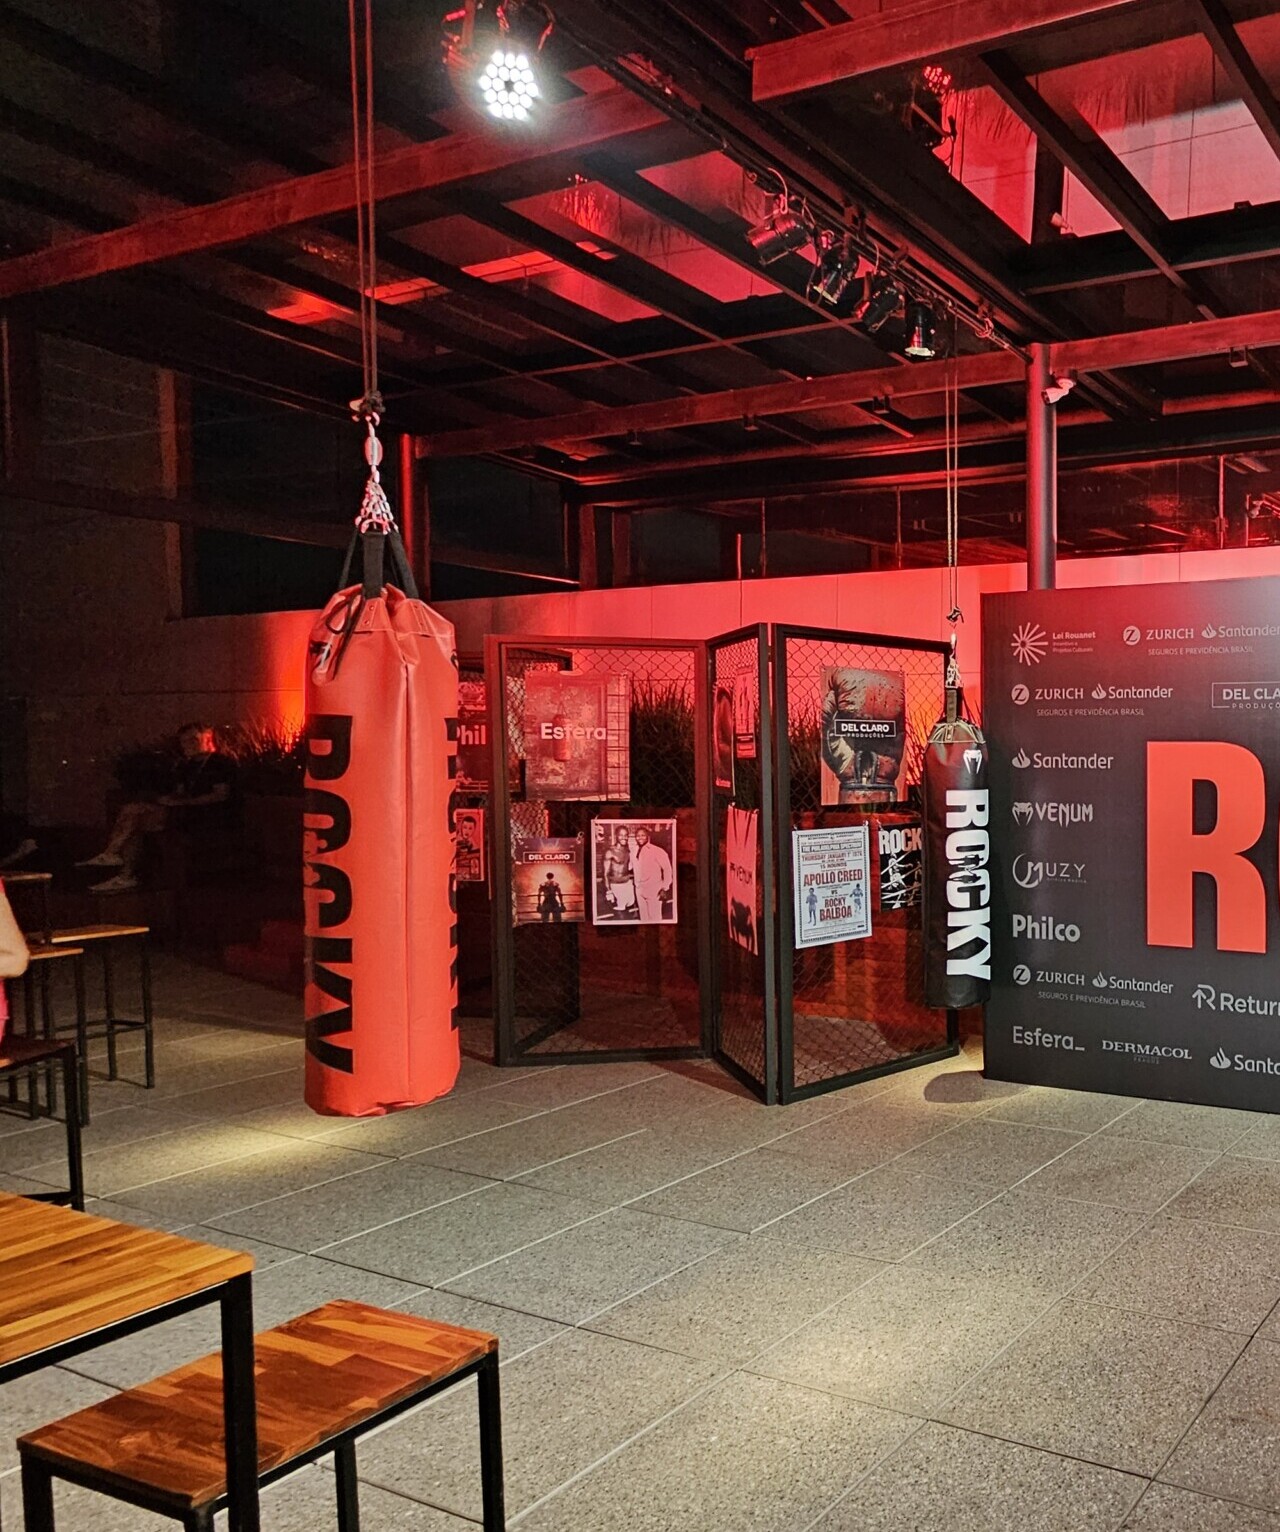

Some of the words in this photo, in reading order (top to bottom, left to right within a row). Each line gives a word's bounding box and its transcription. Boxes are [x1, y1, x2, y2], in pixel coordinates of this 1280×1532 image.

[1146, 628, 1194, 641] ZURICH
[1035, 688, 1084, 700] ZURICH
[1108, 685, 1173, 699] Santander
[1222, 688, 1250, 700] DEL
[456, 724, 487, 745] hil
[840, 723, 859, 732] DEL
[860, 724, 890, 732] CLARO
[1033, 753, 1114, 769] Santander
[1035, 802, 1093, 828] VENUM
[878, 827, 922, 855] ROCK
[803, 871, 835, 887] APOLLO
[837, 869, 863, 883] CREED
[946, 788, 991, 981] ROCKY
[825, 897, 846, 908] ROCKY
[820, 905, 852, 921] BALBOA
[1012, 914, 1081, 942] Philco
[1036, 970, 1085, 986] ZURICH
[1109, 976, 1174, 994] Santander
[1102, 1040, 1192, 1060] DERMACOL
